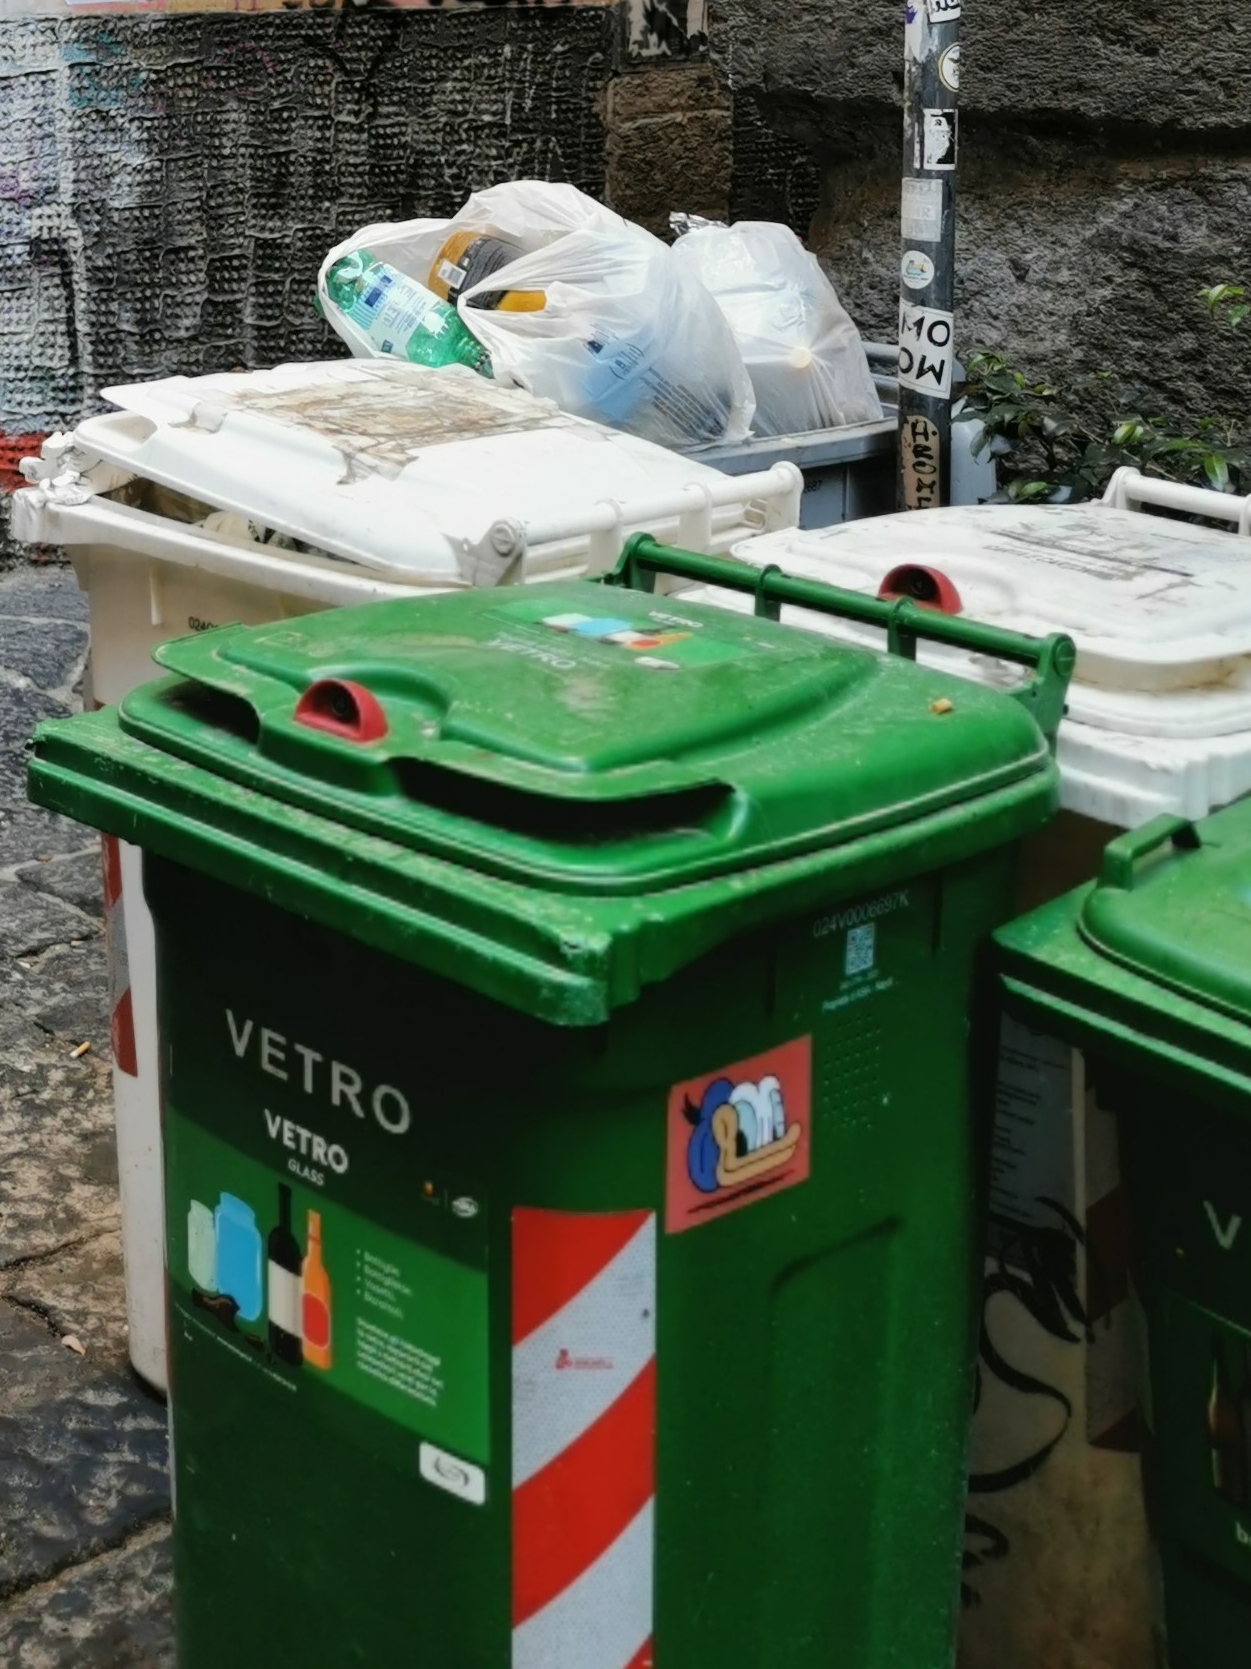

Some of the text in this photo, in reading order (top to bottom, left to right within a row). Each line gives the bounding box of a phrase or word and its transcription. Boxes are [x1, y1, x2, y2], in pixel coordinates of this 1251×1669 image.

[225, 1007, 412, 1135] VETRO
[263, 1108, 350, 1175] VETRO
[287, 1158, 325, 1187] GLASS
